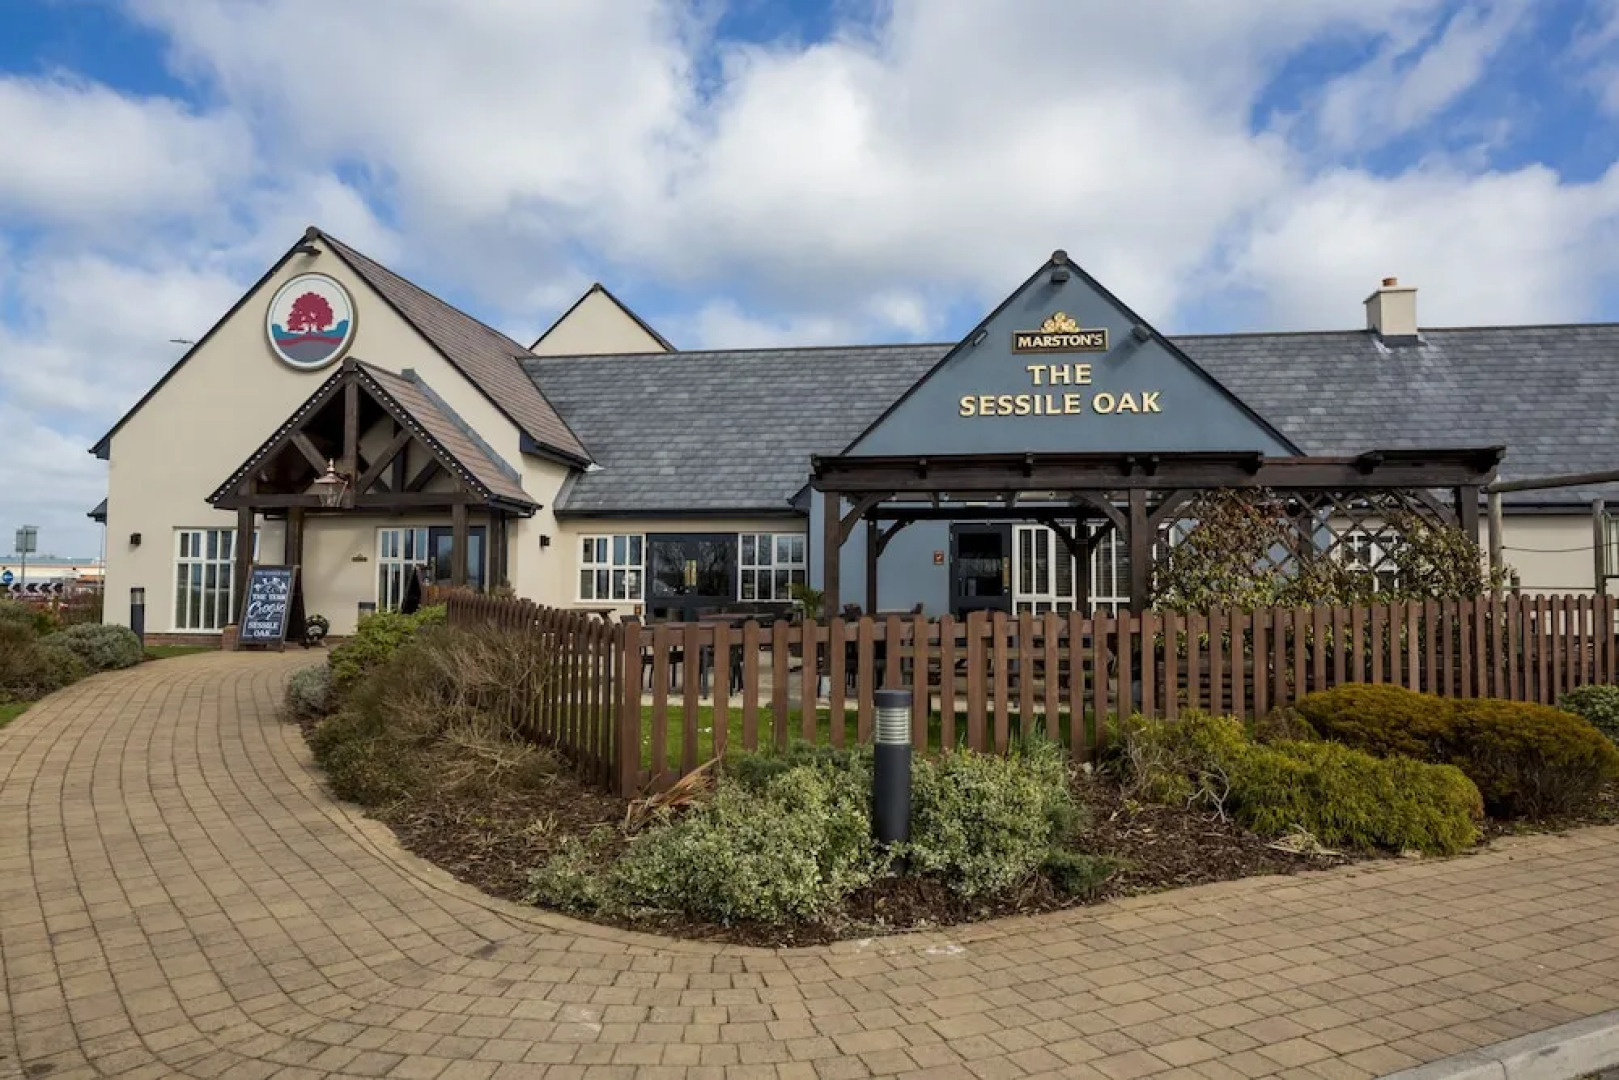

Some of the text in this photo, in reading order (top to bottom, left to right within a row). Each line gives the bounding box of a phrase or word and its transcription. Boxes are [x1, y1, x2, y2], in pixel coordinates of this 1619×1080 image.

[1017, 333, 1103, 348] MARSTON'S
[1027, 363, 1092, 385] THE
[959, 391, 1162, 417] SESSILE OAK
